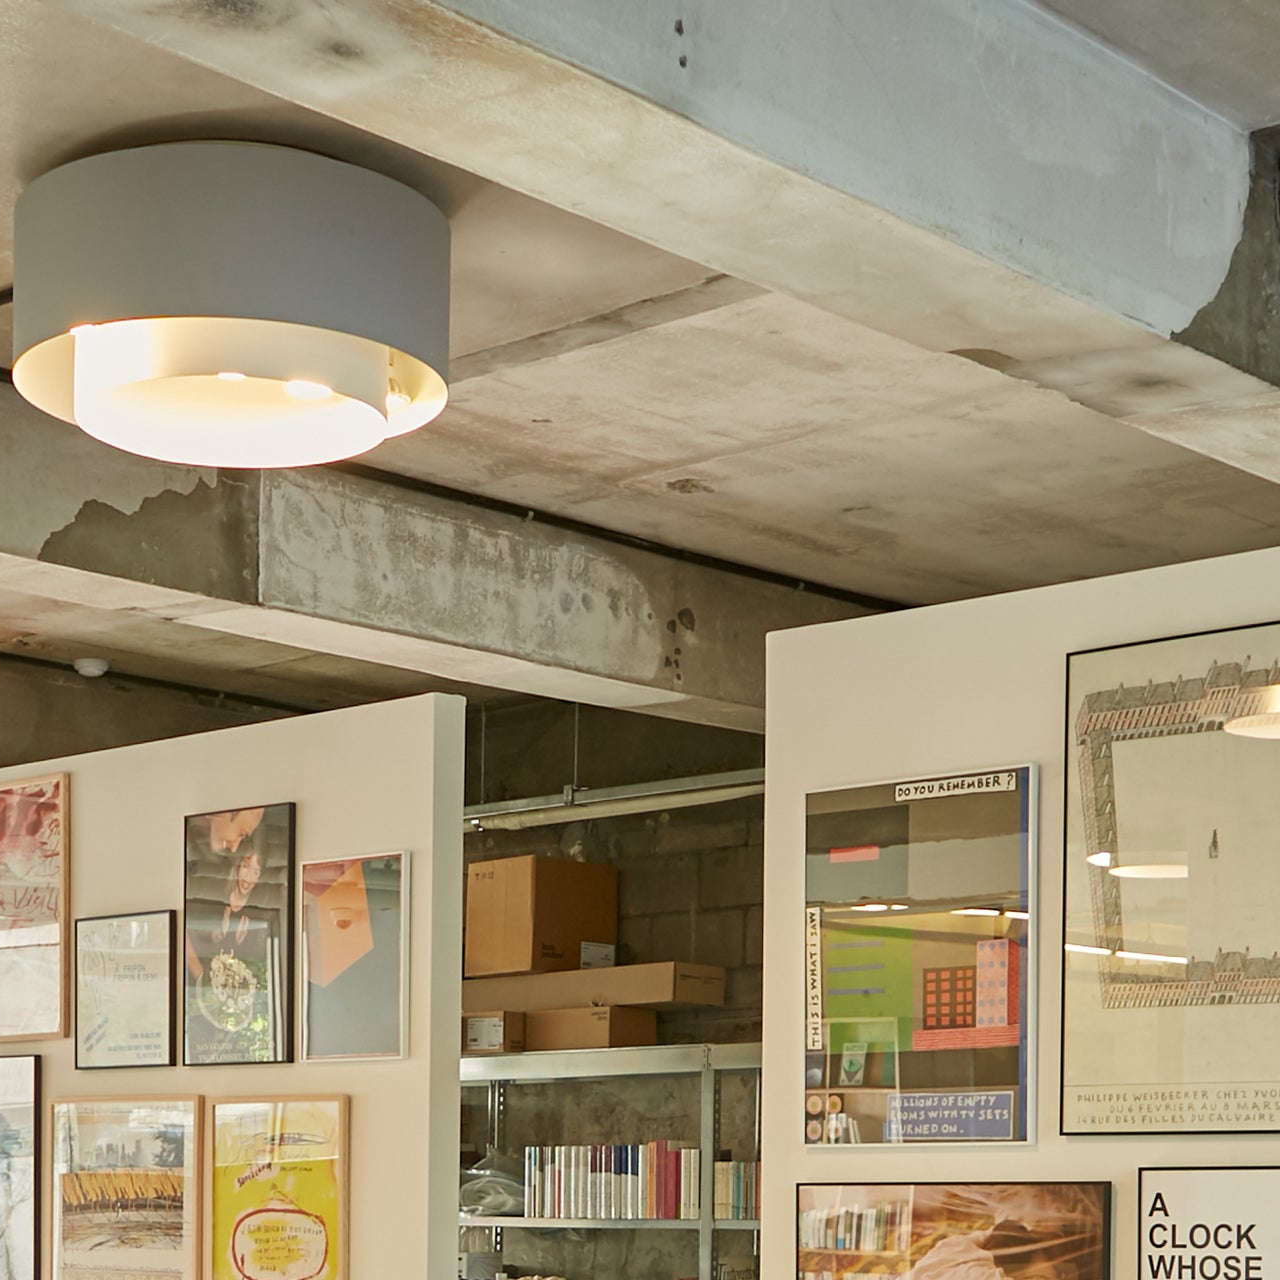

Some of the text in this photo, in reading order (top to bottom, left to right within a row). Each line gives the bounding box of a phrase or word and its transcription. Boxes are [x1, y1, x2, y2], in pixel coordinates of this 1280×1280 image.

[898, 788, 911, 797] DO
[914, 785, 934, 795] YOU
[938, 775, 1001, 792] REMEMBER
[809, 911, 818, 937] SAW
[809, 952, 818, 990] WHAT
[809, 994, 819, 1006] IS
[809, 1011, 820, 1047] THIS
[941, 1096, 955, 1107] OF
[957, 1095, 996, 1107] EMPTY
[1077, 1093, 1128, 1102] PHILIPPE
[1216, 1089, 1248, 1099] CHEZ
[927, 1108, 958, 1119] WITH
[960, 1110, 975, 1119] TV
[978, 1108, 1009, 1120] SETS
[1109, 1104, 1124, 1114] DU
[1201, 1102, 1217, 1112] AU
[1237, 1101, 1280, 1111] MARS
[1090, 1115, 1111, 1125] RUE
[1115, 1114, 1136, 1124] DES
[1141, 1113, 1185, 1124] FILLES
[1191, 1112, 1205, 1123] DU
[1208, 1112, 1276, 1122] CALVAIRE
[1148, 1192, 1170, 1217] A
[1149, 1223, 1257, 1250] CLOCK
